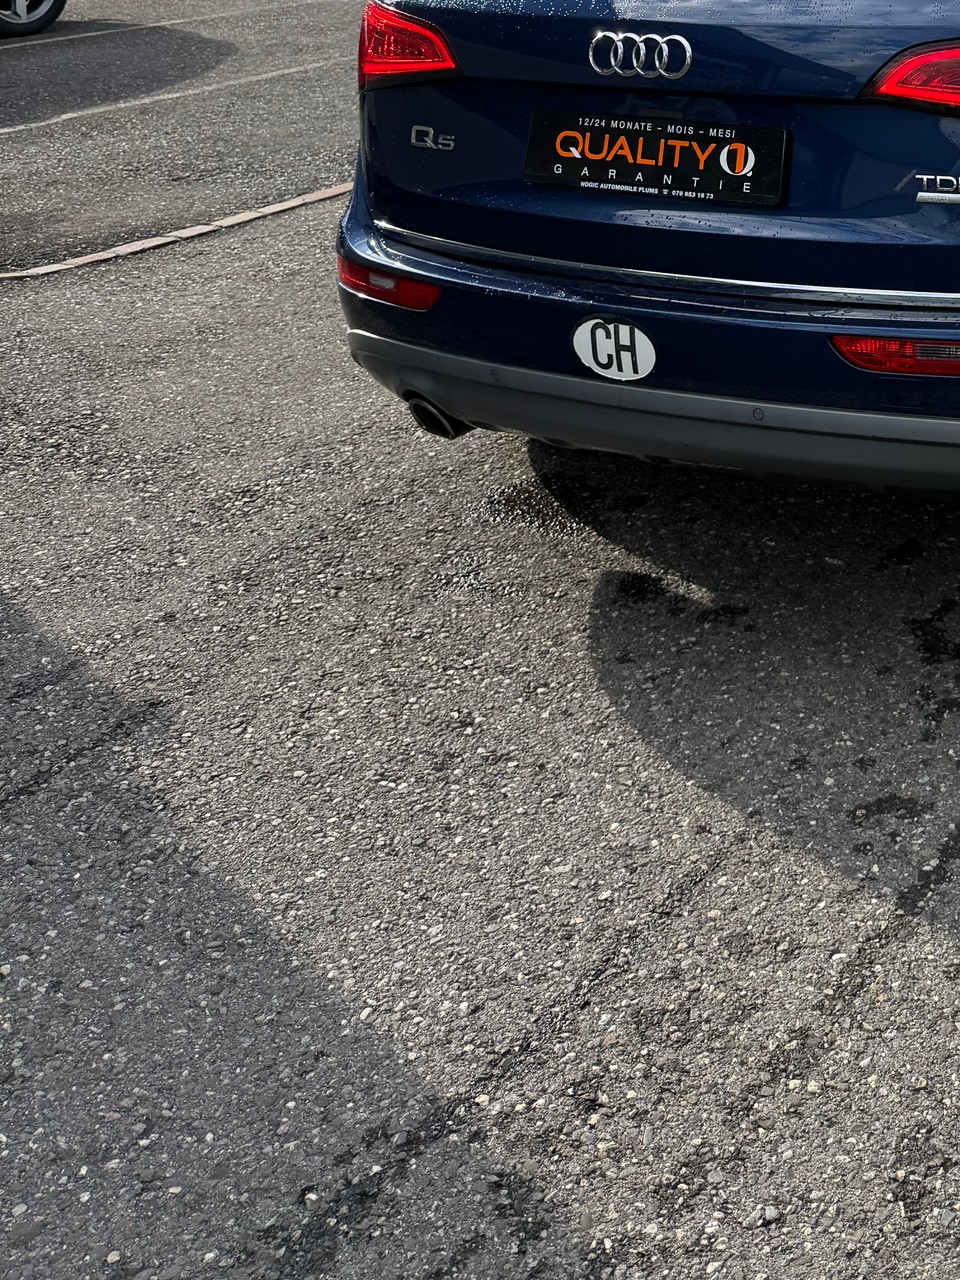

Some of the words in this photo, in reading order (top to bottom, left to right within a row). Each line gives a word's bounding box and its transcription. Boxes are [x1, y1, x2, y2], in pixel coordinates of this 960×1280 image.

[411, 125, 455, 150] Q5
[578, 117, 606, 128] 12/24
[610, 120, 653, 131] MONATE
[667, 124, 694, 135] MOIS
[709, 127, 736, 138] MESI
[555, 130, 717, 170] QUALITY
[553, 163, 751, 193] GARANTIE
[600, 183, 637, 192] AUTOMOBILE
[638, 186, 659, 194] FLUMS
[590, 321, 639, 375] CH
